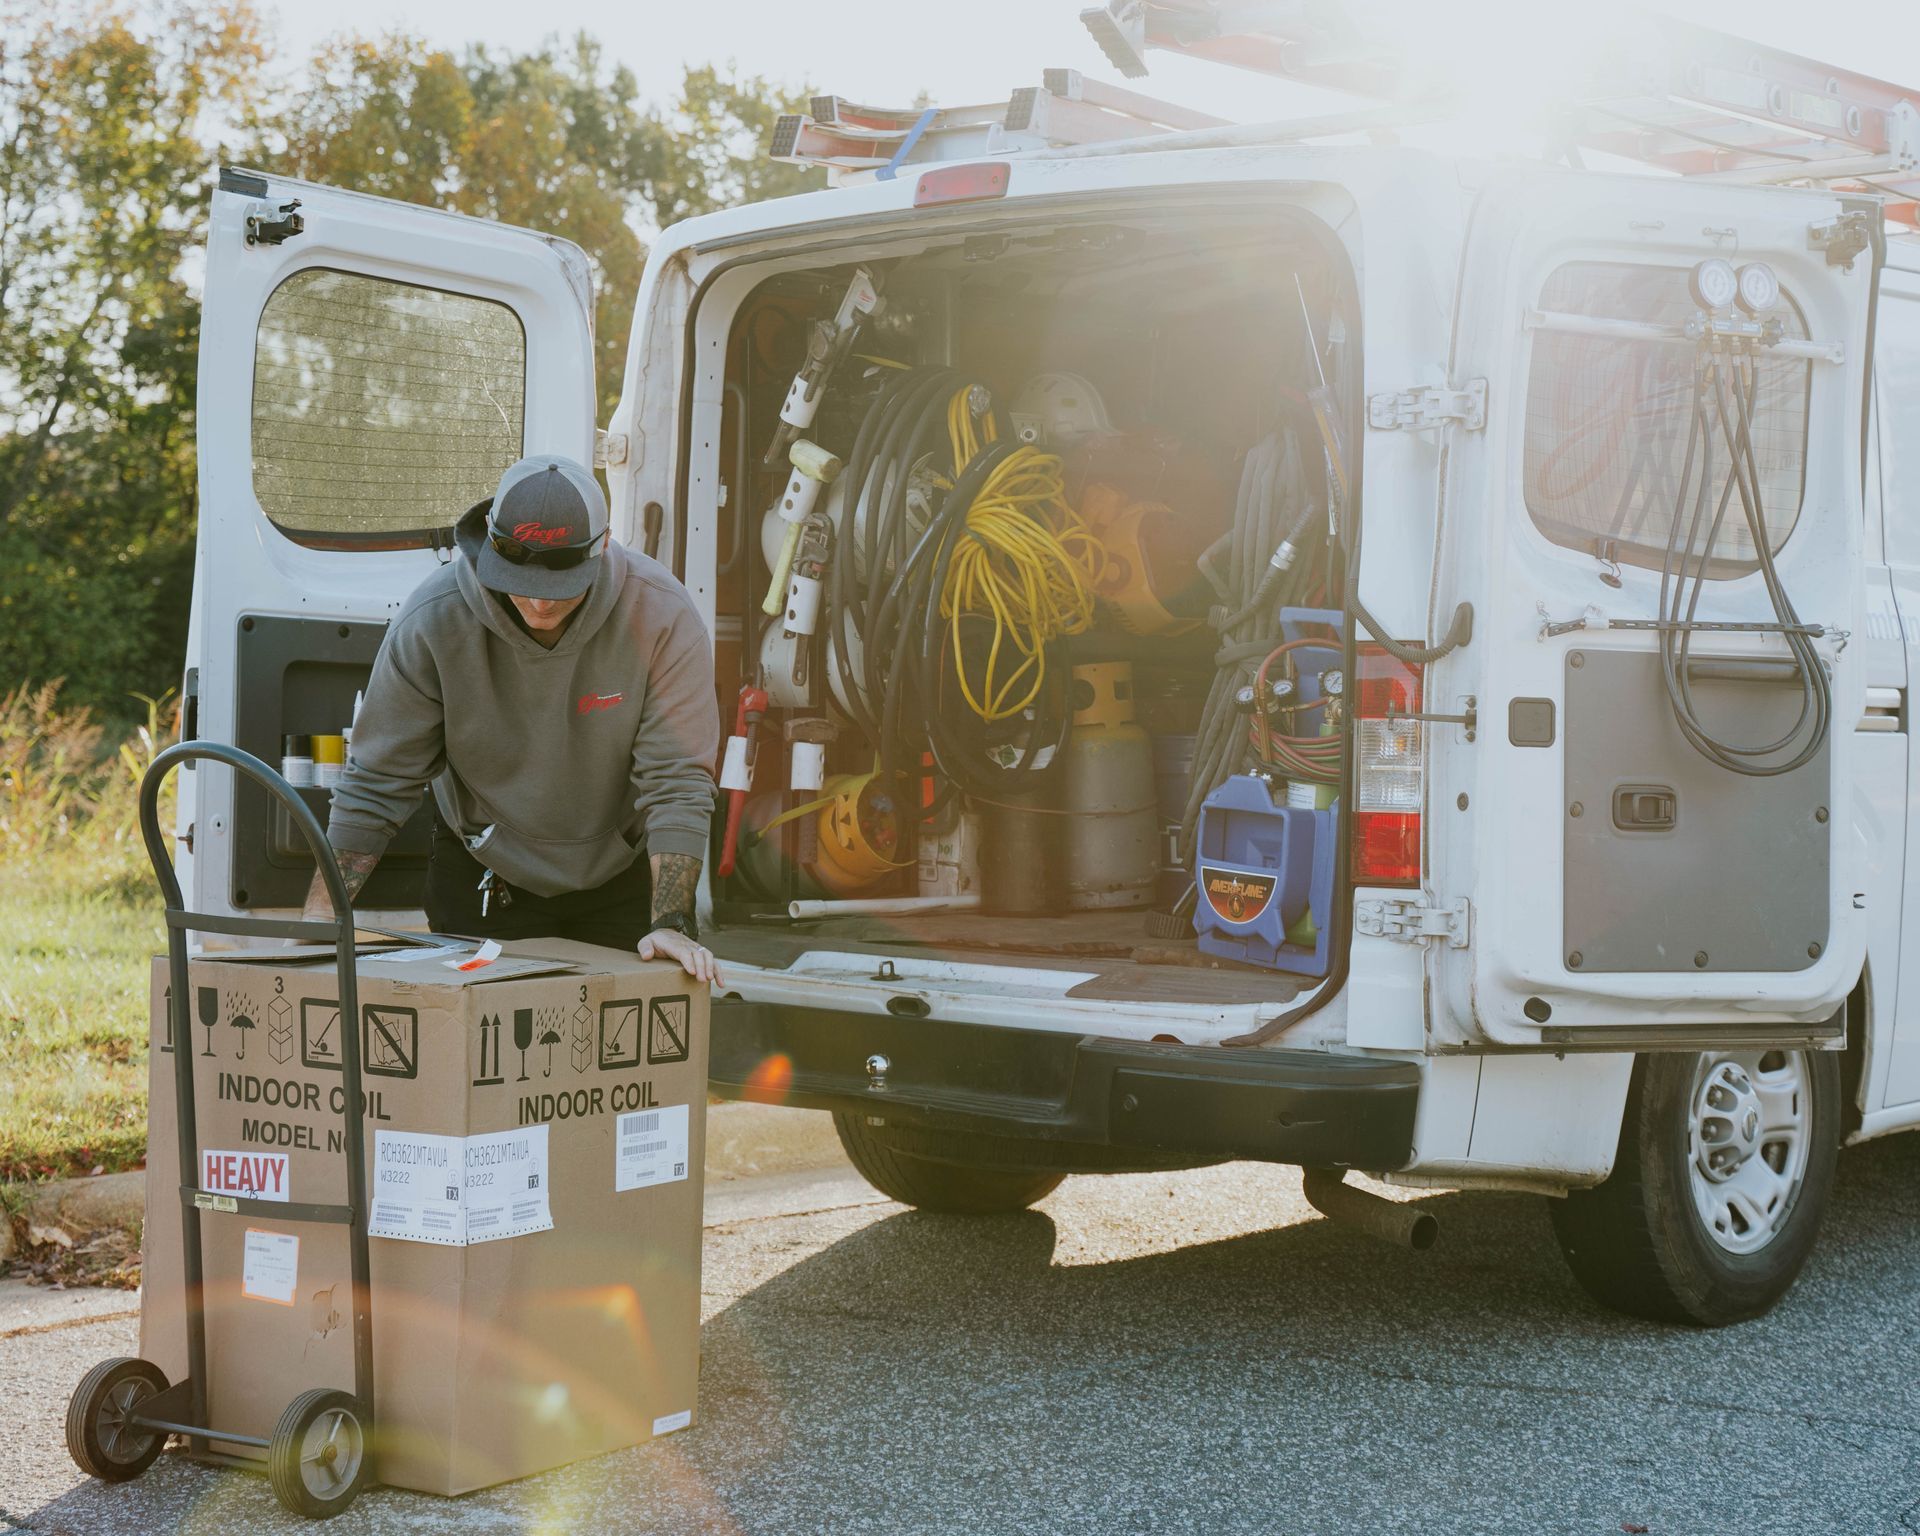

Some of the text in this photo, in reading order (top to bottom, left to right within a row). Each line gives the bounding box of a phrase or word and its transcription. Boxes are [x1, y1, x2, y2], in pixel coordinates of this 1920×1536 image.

[274, 976, 284, 994] 3
[580, 985, 588, 1003] 3
[218, 1072, 321, 1111] INDOOR
[518, 1081, 659, 1125] INDOOR COIL
[242, 1118, 348, 1154] MODEL N
[206, 1155, 285, 1193] HEAVY
